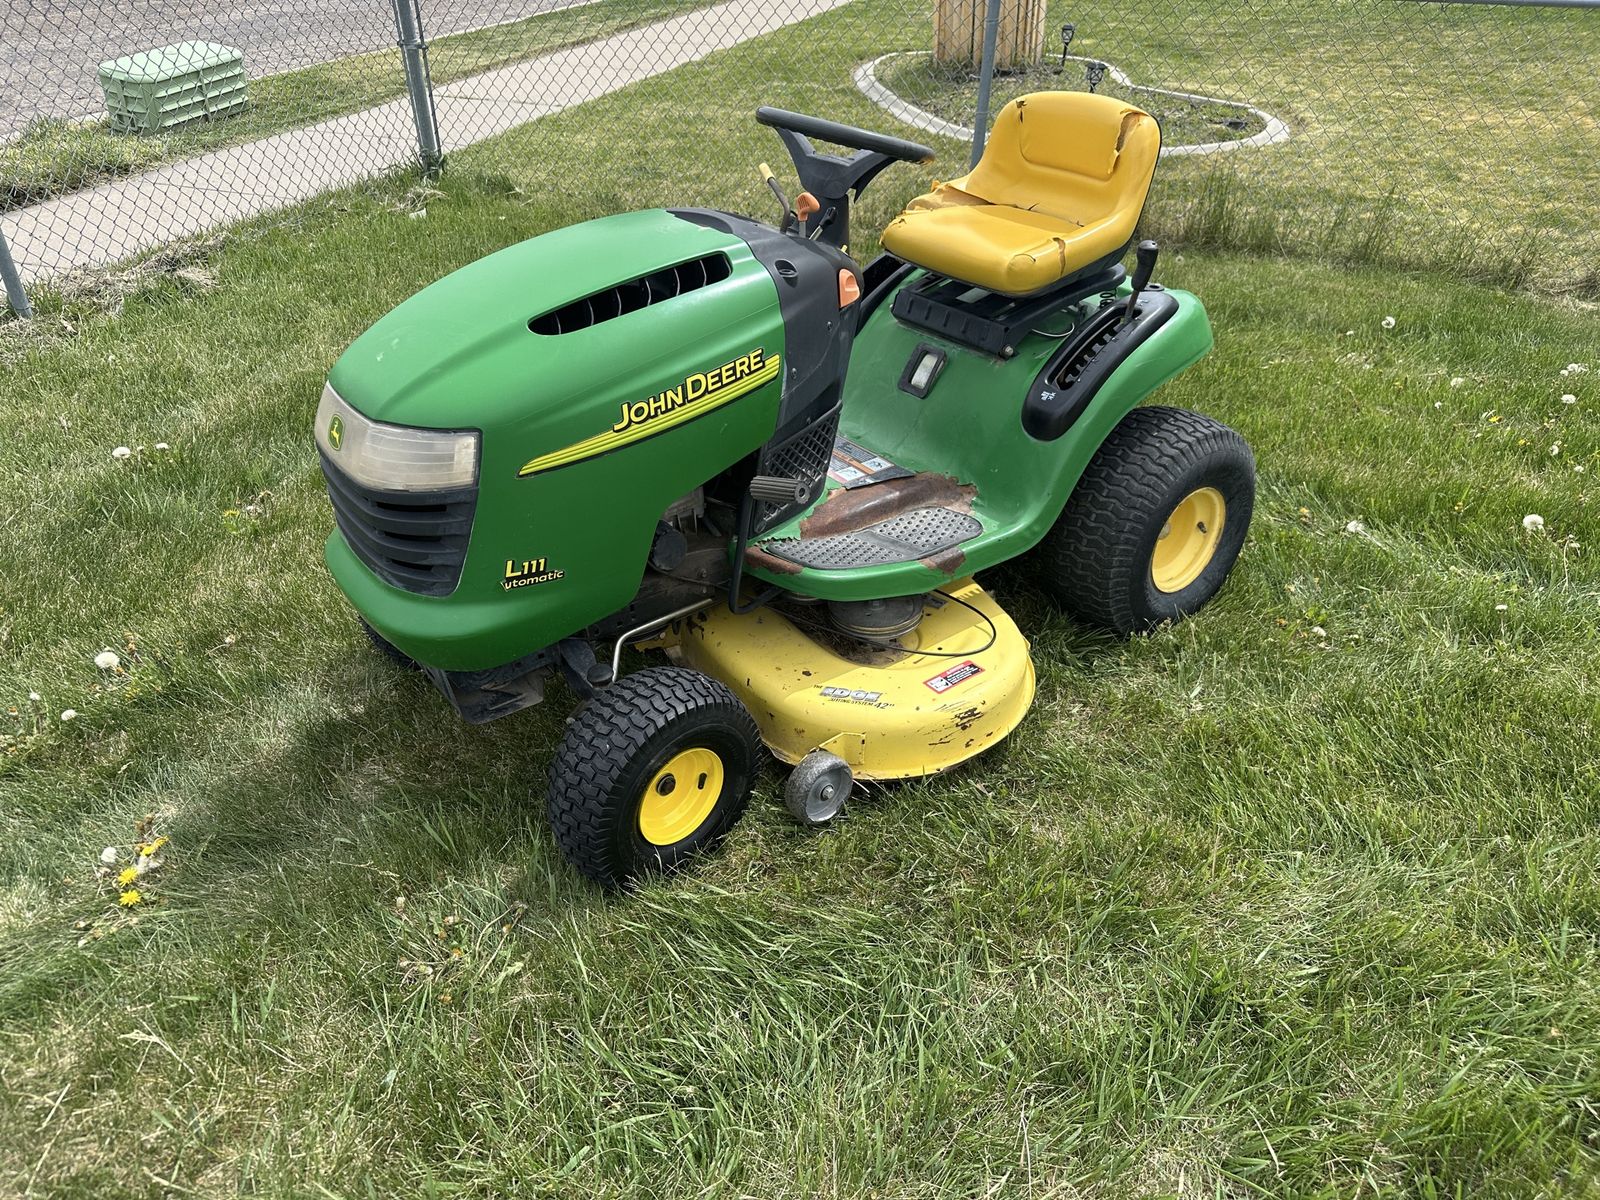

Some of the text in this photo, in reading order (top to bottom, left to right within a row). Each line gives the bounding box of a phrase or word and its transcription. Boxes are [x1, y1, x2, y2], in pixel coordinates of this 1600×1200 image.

[613, 347, 765, 432] JOHN DEERE
[505, 557, 547, 578] L111
[501, 570, 565, 590] utomatic
